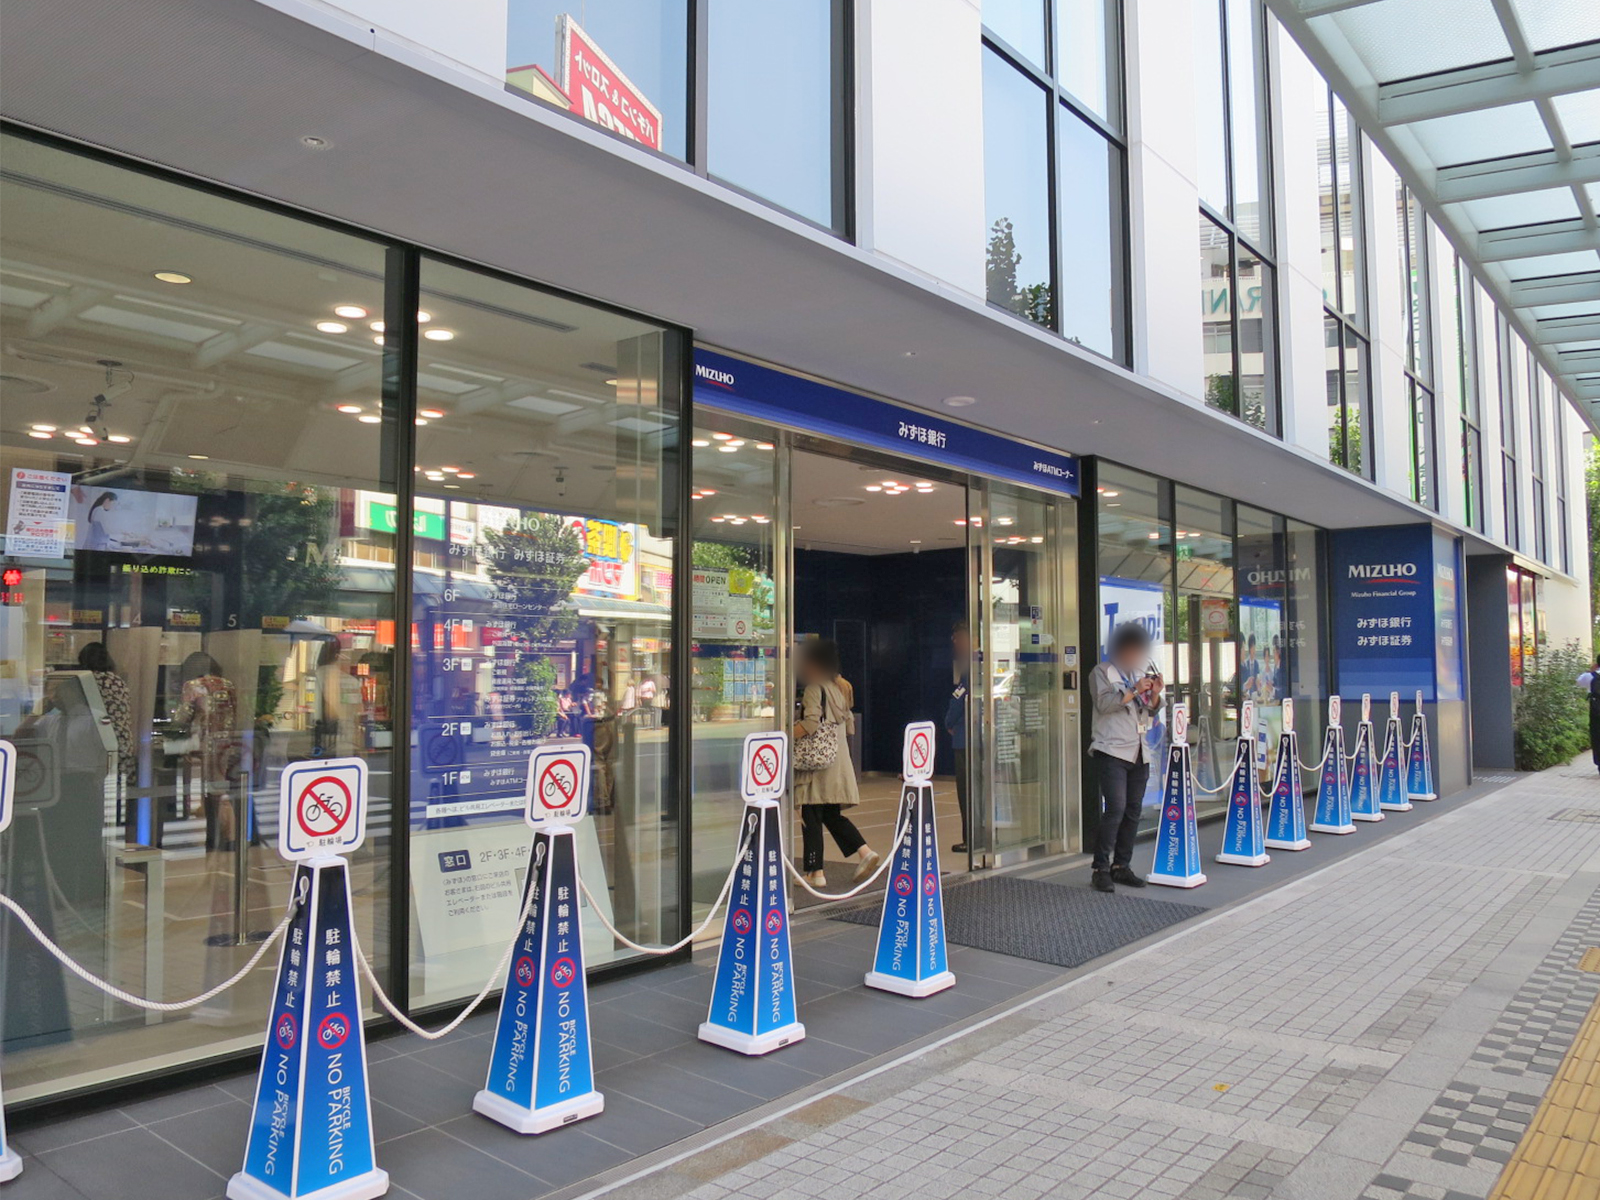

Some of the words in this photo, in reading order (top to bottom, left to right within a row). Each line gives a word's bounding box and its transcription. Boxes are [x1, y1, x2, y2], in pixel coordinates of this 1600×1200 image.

[695, 364, 735, 386] MIZUHO
[898, 421, 947, 449] みずほ銀行
[1033, 461, 1074, 479] みずほATMコーナー
[514, 548, 566, 565] みずほ証券
[705, 576, 726, 584] OPEN
[1348, 563, 1417, 579] MIZUHO
[444, 589, 460, 601] 6F
[227, 614, 237, 627] 5
[444, 619, 460, 631] 4F
[1357, 617, 1412, 628] みずほ銀行
[1357, 635, 1412, 646] みずほ証券
[443, 658, 459, 671] 3F
[442, 723, 459, 736] 2F
[442, 772, 458, 785] 1F
[319, 836, 343, 847] 駐輪場
[1169, 822, 1177, 835] NO
[444, 855, 466, 868] 窓口
[768, 850, 777, 906] 駐輪禁止
[557, 886, 570, 953] 駐輪禁止
[897, 898, 907, 917] NO
[928, 898, 934, 917] NO
[734, 938, 745, 960] NO
[771, 938, 779, 960] NO
[892, 920, 905, 971] PARKING
[928, 920, 936, 970] PARKING
[285, 928, 304, 1008] 駐輪禁止
[325, 928, 342, 1008] 駐輪禁止
[516, 990, 528, 1017] NO
[558, 991, 570, 1018] NO
[728, 962, 744, 1023] PARKING
[772, 963, 780, 1023] PARKING
[519, 1023, 529, 1061] BICYCLE
[569, 1019, 577, 1056] BICYCLE
[276, 1054, 290, 1085] NO
[327, 1053, 343, 1085] NO
[505, 1020, 524, 1093] PARKING
[558, 1021, 571, 1093] PARKING
[279, 1093, 290, 1138] BICYCLE
[342, 1086, 351, 1130] BICYCLE
[264, 1089, 284, 1176] PARKING
[328, 1088, 344, 1176] PARKING
